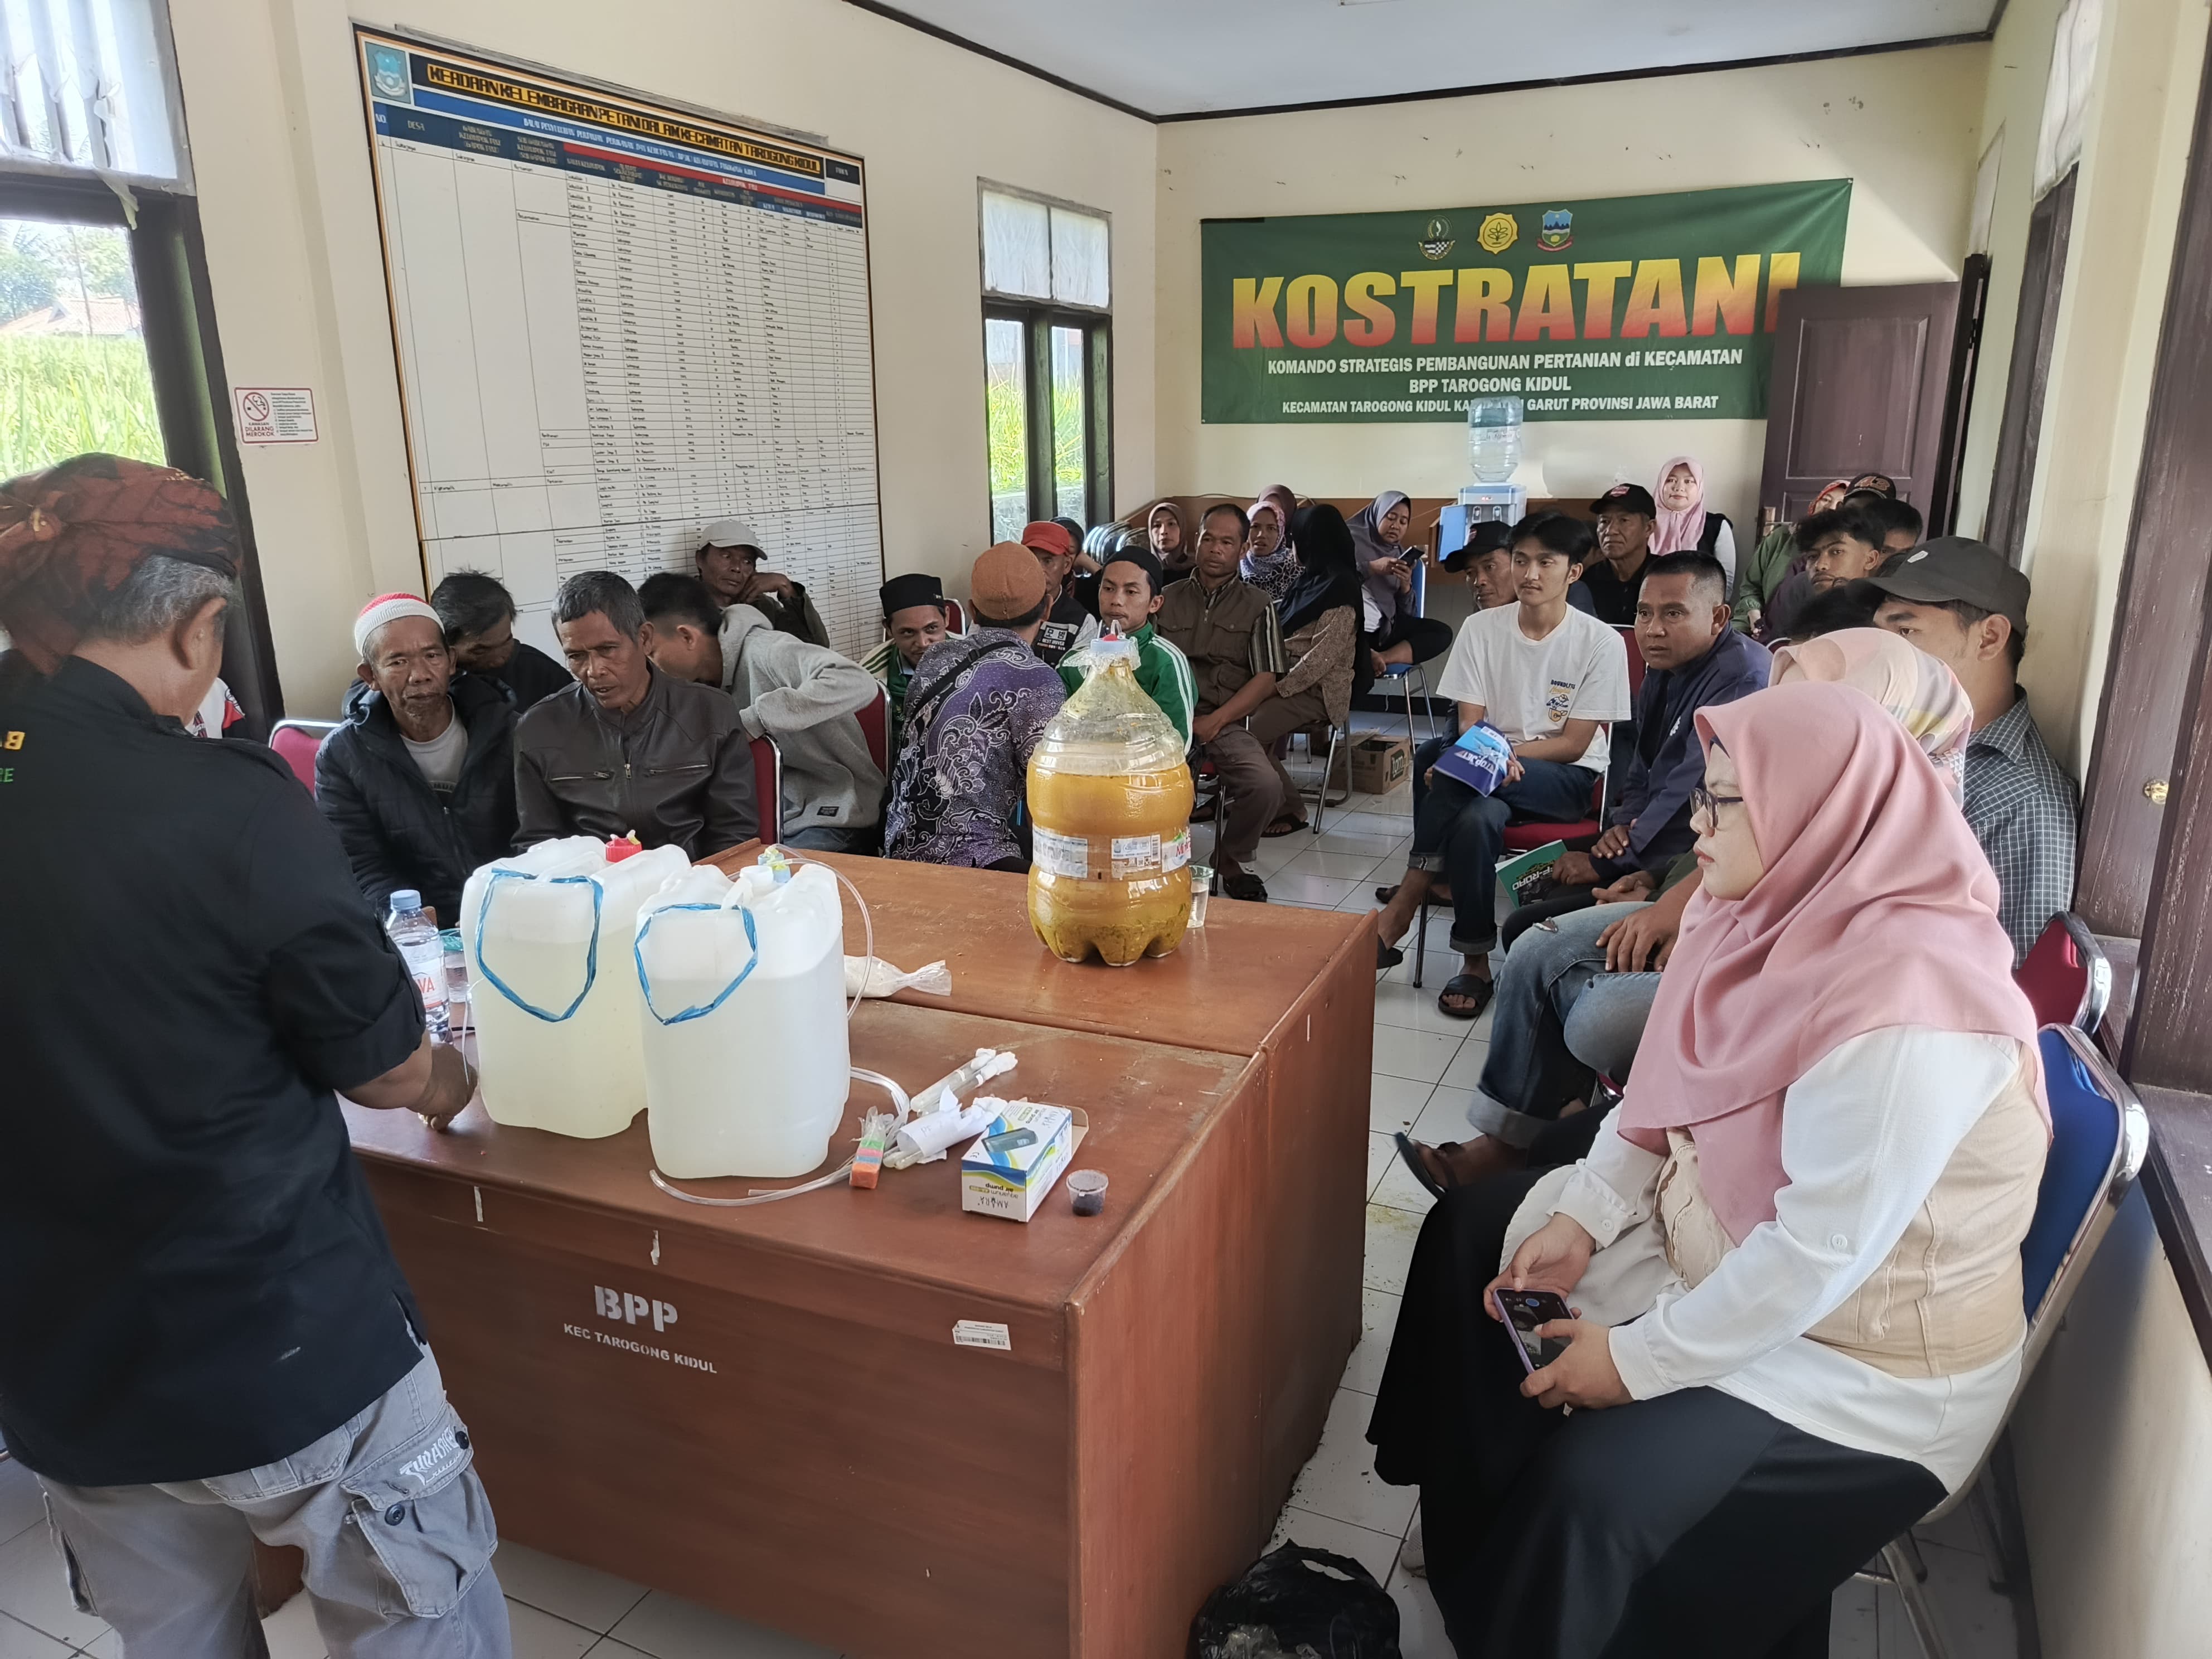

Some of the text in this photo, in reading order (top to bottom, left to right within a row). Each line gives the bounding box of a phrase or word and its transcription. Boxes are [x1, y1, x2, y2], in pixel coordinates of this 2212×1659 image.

[429, 65, 499, 96] KEADAAN
[1231, 252, 1801, 350] KOSTRATANI
[1268, 349, 1743, 374] KOMANDO STRATEGIS PEMBANGUNAN PERTANIAN di KECAMATAN
[1409, 376, 1571, 393] BPP TAROGONG KIDUL
[1283, 401, 1347, 413] KECAMATAN
[1350, 400, 1413, 413] TAROGONG
[1415, 400, 1451, 412] KIDUL
[1527, 398, 1569, 411] GARUT
[1571, 397, 1633, 410] PROVINSI
[1636, 396, 1671, 410] JAWA
[1674, 395, 1719, 409] BARAT
[1512, 866, 1554, 891] F-ROAD
[418, 976, 435, 993] VA
[594, 1285, 678, 1332] BPP
[564, 1323, 717, 1374] KEC TAROGONG KIDUL
